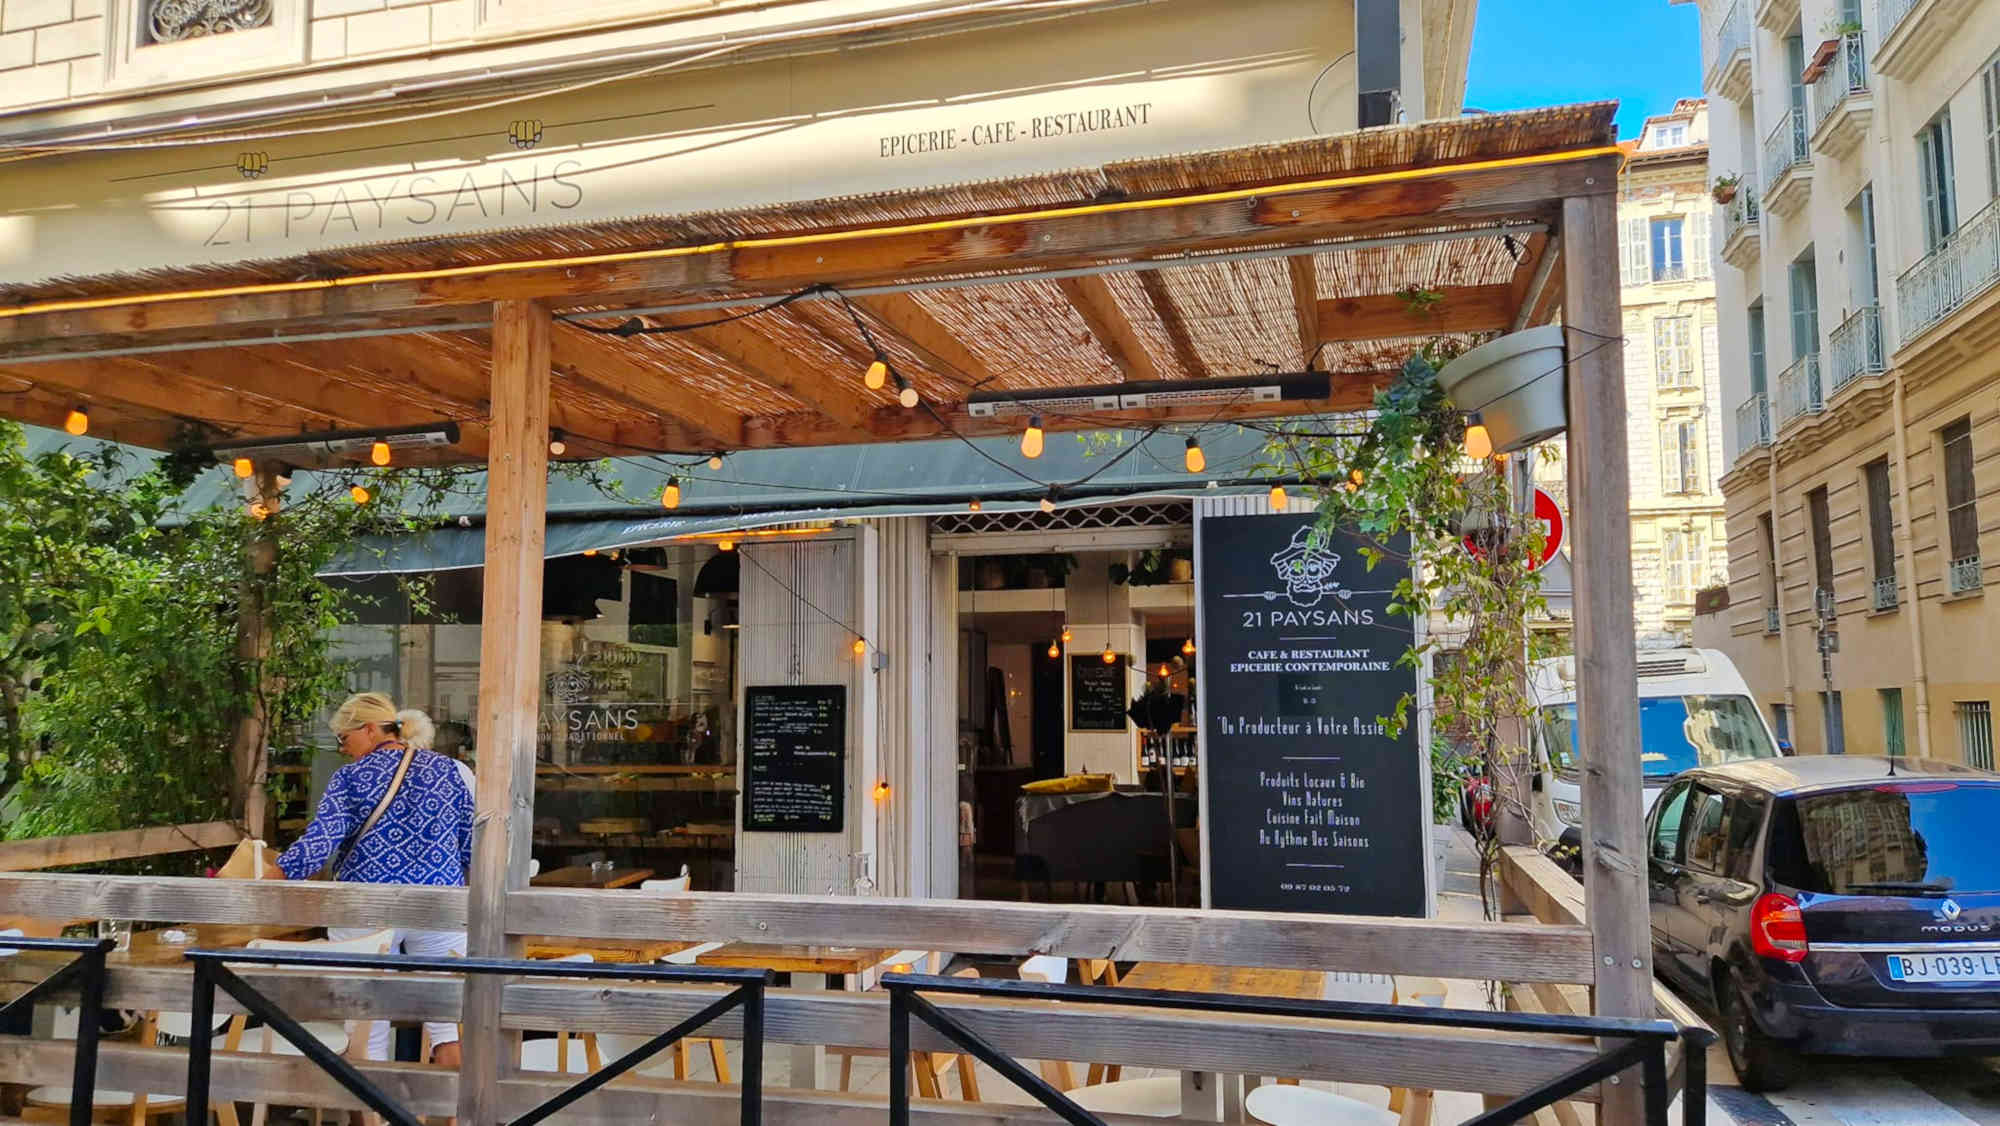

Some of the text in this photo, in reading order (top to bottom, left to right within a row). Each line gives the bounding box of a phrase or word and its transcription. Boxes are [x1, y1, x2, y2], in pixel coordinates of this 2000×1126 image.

[879, 128, 958, 158] EPICERIE
[972, 120, 1017, 147] CAFE
[1031, 103, 1153, 139] RESTAURANT
[203, 160, 584, 247] 21 PAYSANS
[1242, 609, 1375, 628] 21 PAYSANS
[1247, 649, 1371, 660] CAFE & RESTAURANT
[1230, 661, 1391, 673] EPICERIE CONTEMPORAINE
[538, 709, 639, 731] AYSANS
[1239, 716, 1301, 736] Producteur
[1306, 720, 1313, 735] à
[1317, 716, 1349, 736] Votre
[1260, 771, 1300, 788] Produits
[1304, 772, 1336, 788] Locaux
[1350, 772, 1366, 788] Bio
[1282, 791, 1343, 807] Vins Natures
[1267, 808, 1361, 826] Cuisine Fait Maison
[1312, 830, 1329, 846] Des
[1333, 831, 1369, 848] Saisons
